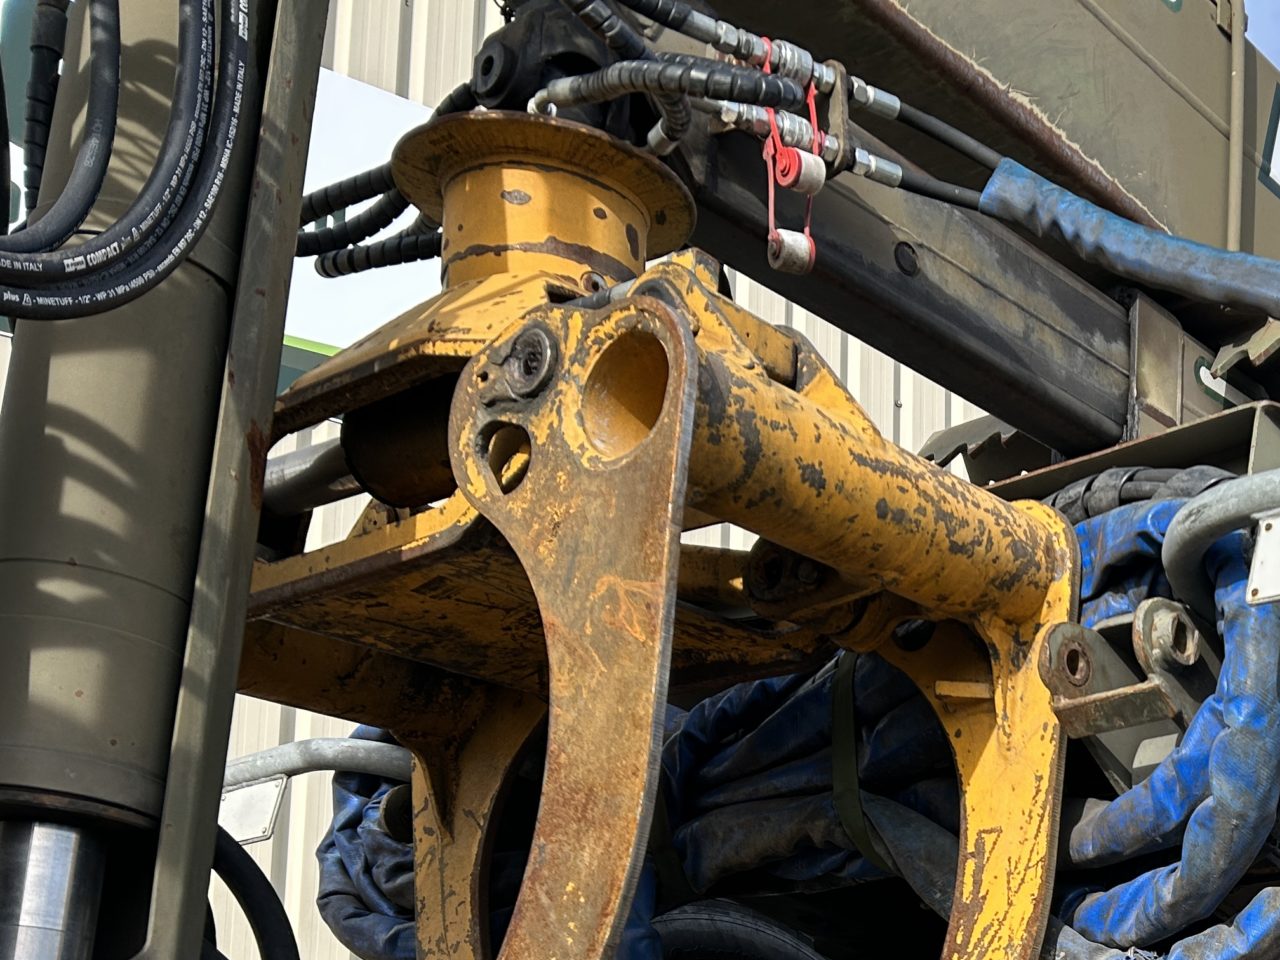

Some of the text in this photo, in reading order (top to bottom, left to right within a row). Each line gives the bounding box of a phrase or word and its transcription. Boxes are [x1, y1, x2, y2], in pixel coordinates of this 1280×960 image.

[3, 290, 20, 302] plus
[36, 296, 73, 306] MINETUFF
[95, 291, 107, 301] WP
[106, 288, 116, 298] 31
[114, 284, 130, 295] MPa
[192, 217, 203, 230] DN
[198, 210, 207, 219] 12
[214, 171, 224, 186] R16
[219, 148, 231, 169] MSHA
[232, 90, 242, 114] MADE
[237, 60, 245, 83] ITALY
[86, 241, 120, 266] COMPACT
[139, 202, 162, 231] MINETUFF
[13, 261, 22, 270] IN
[22, 261, 43, 272] ITALY
